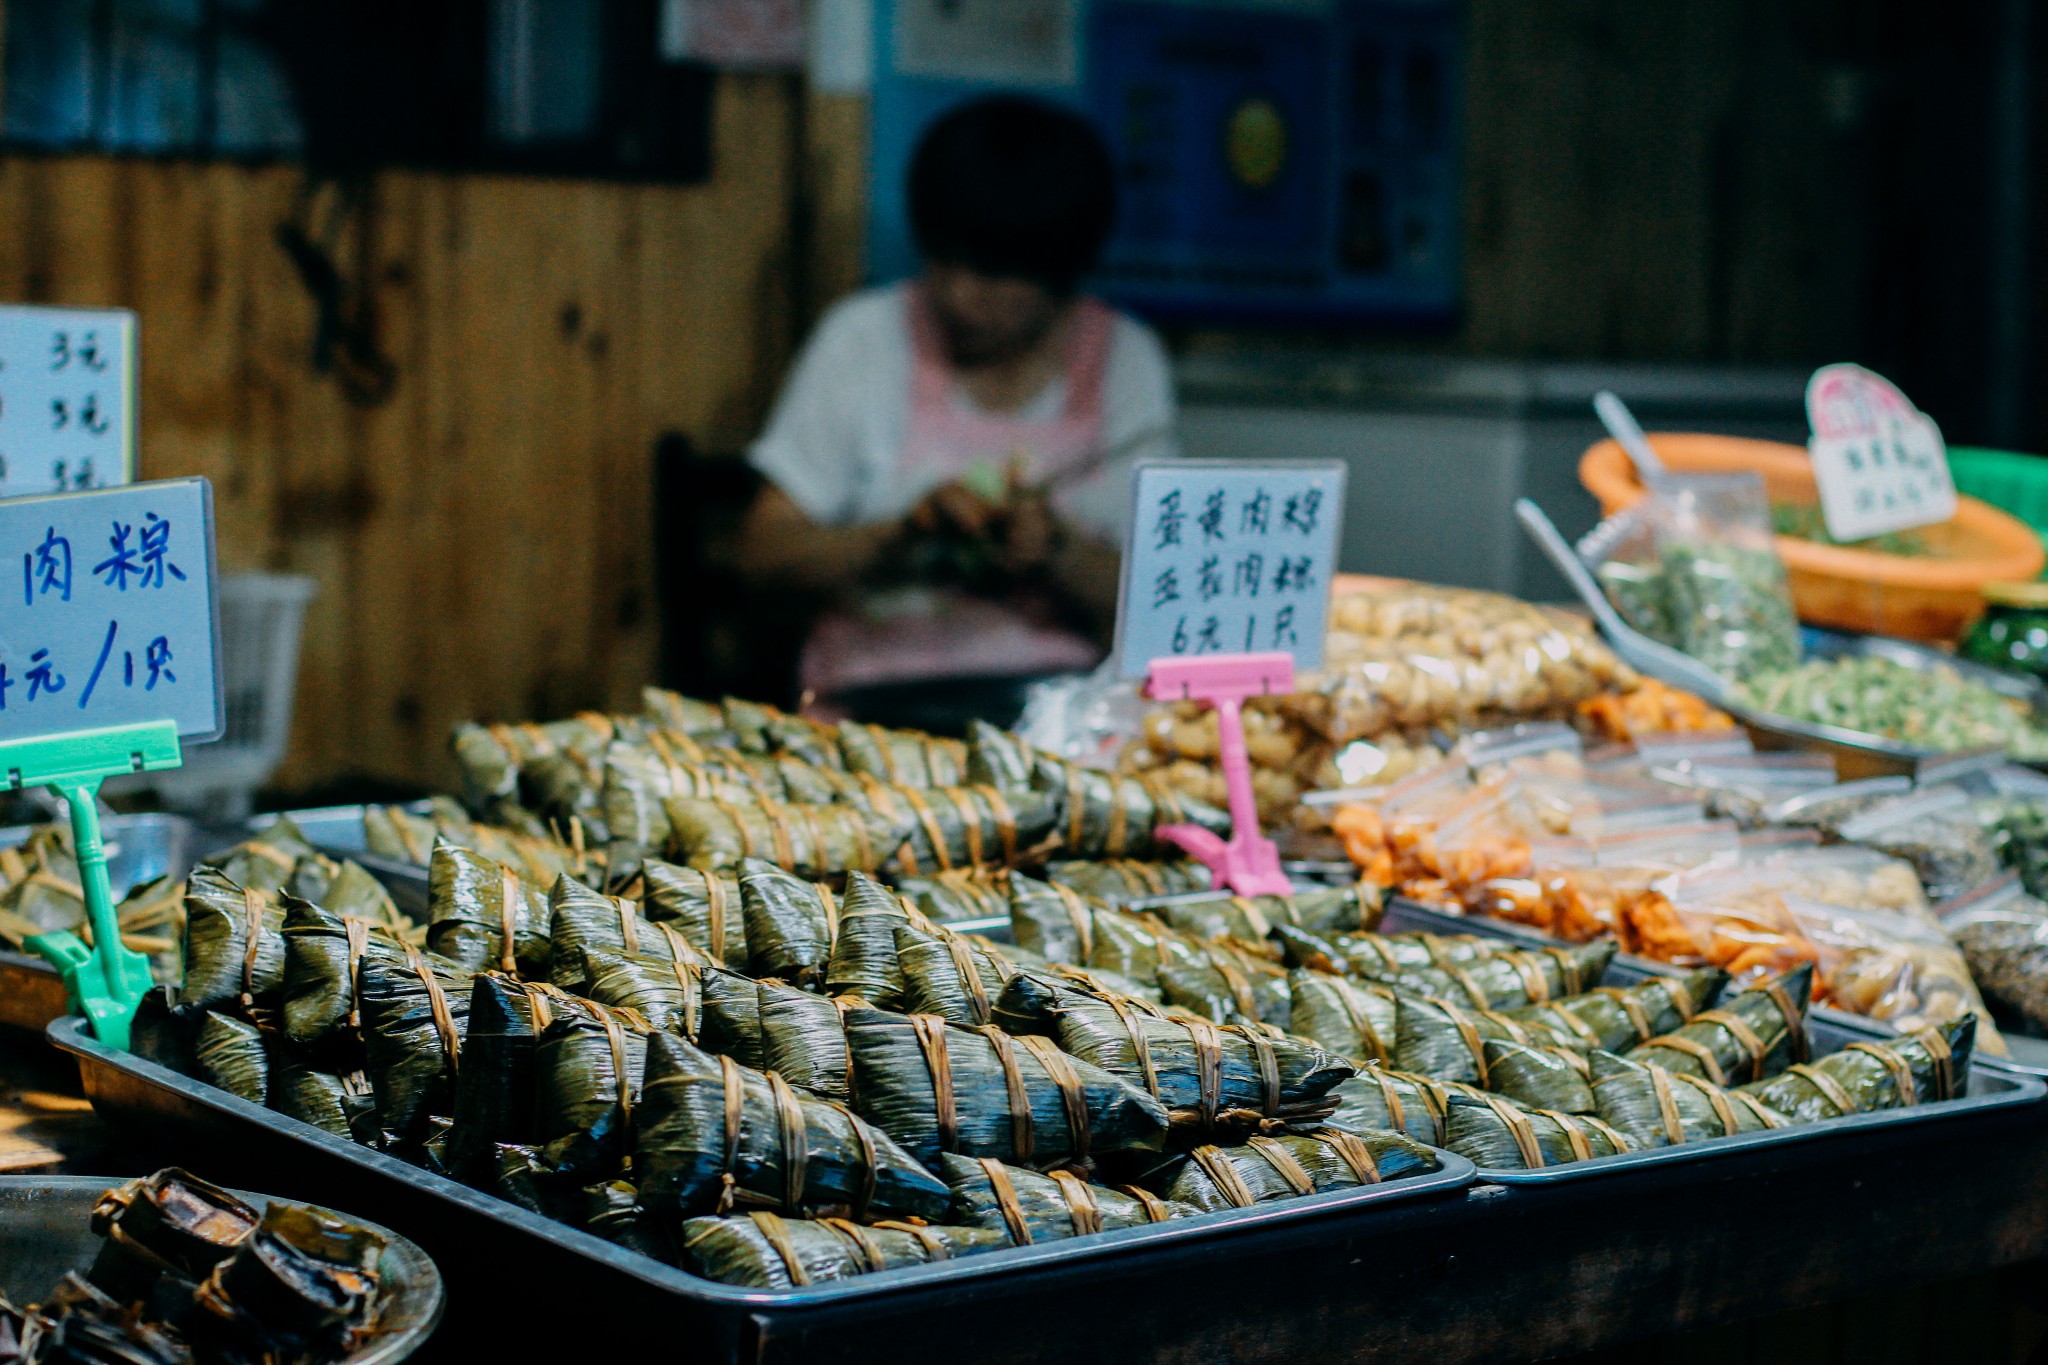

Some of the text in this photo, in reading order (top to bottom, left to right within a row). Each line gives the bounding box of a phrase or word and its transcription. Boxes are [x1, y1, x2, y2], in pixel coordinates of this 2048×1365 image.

[51, 331, 108, 372] 3元
[51, 394, 109, 435] 3元
[24, 512, 187, 606] 肉粽
